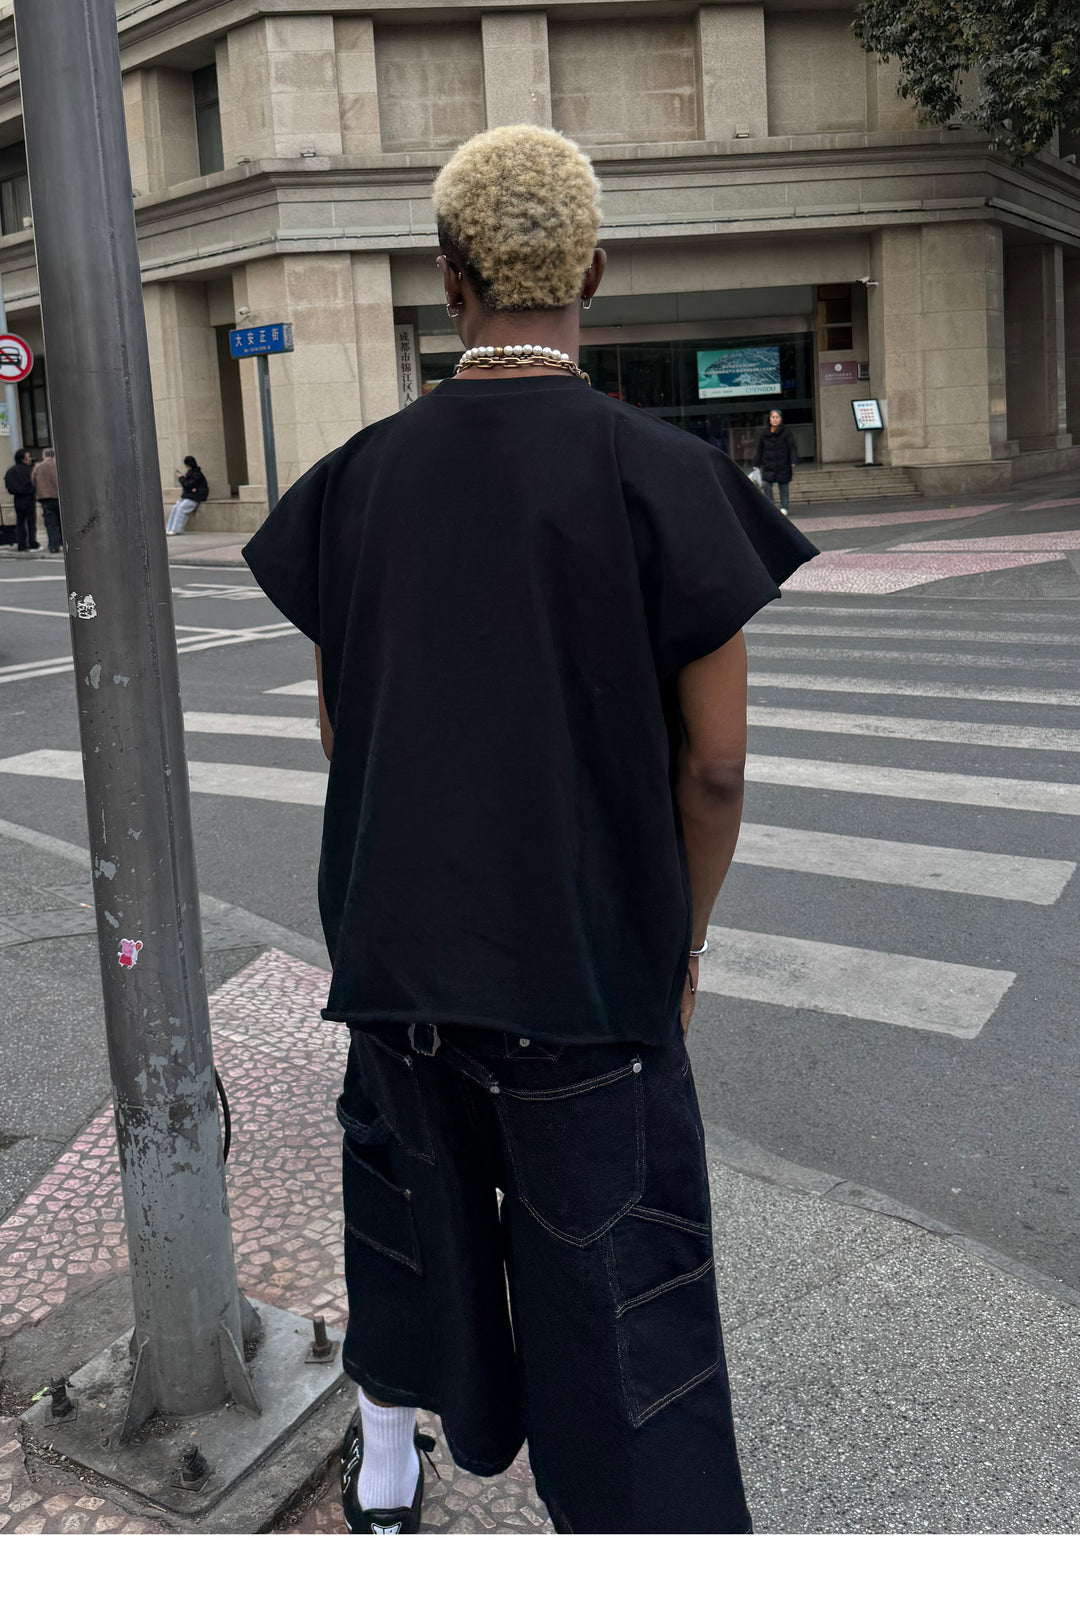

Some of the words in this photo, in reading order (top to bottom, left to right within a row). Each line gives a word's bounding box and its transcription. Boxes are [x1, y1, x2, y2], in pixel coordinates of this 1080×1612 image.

[235, 328, 279, 347] 大安正街
[400, 331, 413, 407] 成都市锦江区人
